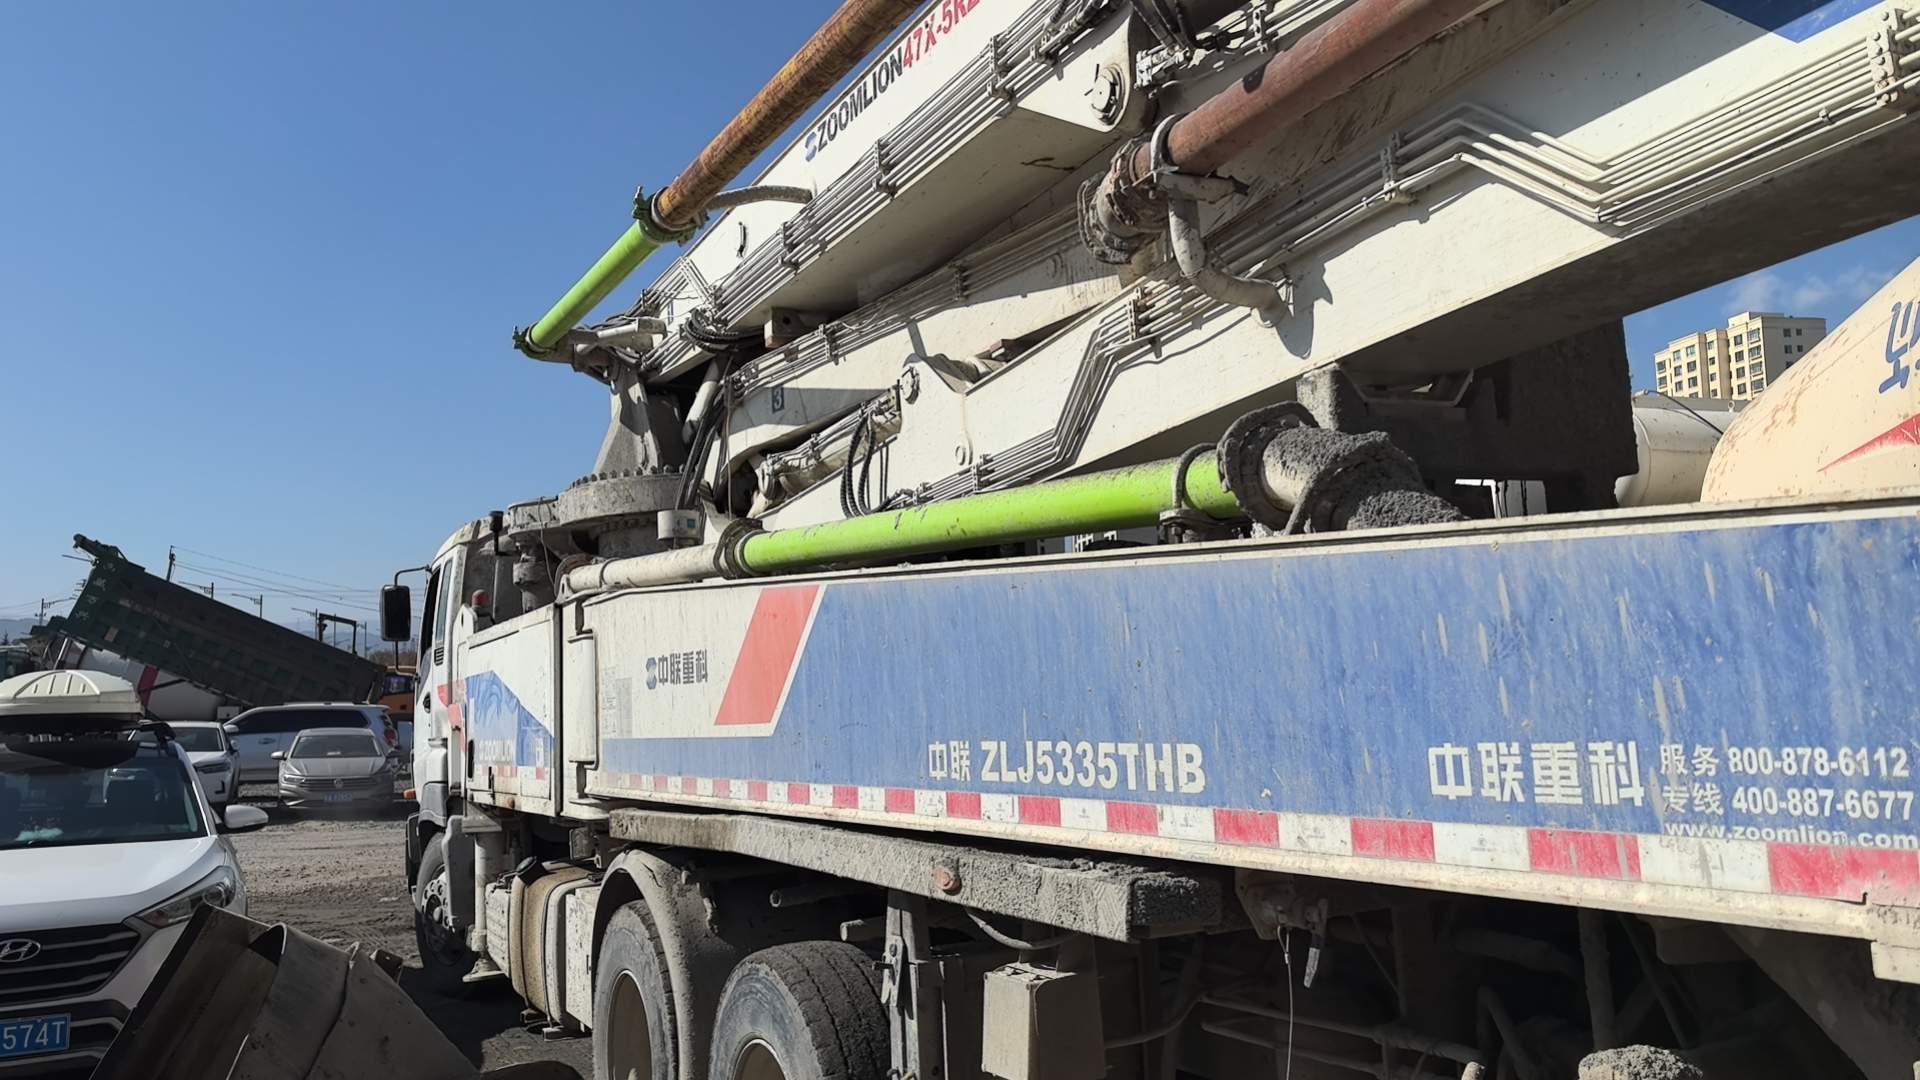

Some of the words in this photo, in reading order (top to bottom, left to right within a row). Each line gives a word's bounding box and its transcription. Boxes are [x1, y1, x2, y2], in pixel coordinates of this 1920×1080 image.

[816, 46, 903, 154] ZOOMLION
[657, 648, 708, 686] 中联重科
[928, 740, 971, 782] 中联
[980, 740, 1206, 794] ZLJ5335THB
[1428, 741, 1645, 807] 中联重科
[1660, 743, 1719, 777] 服务
[1728, 746, 1910, 778] 800-878-6112
[1662, 783, 1725, 816] 专线
[1731, 786, 1914, 821] 400-887-6677
[1664, 821, 1919, 849] www.zoomlion.com
[2, 1021, 65, 1050] 574T
